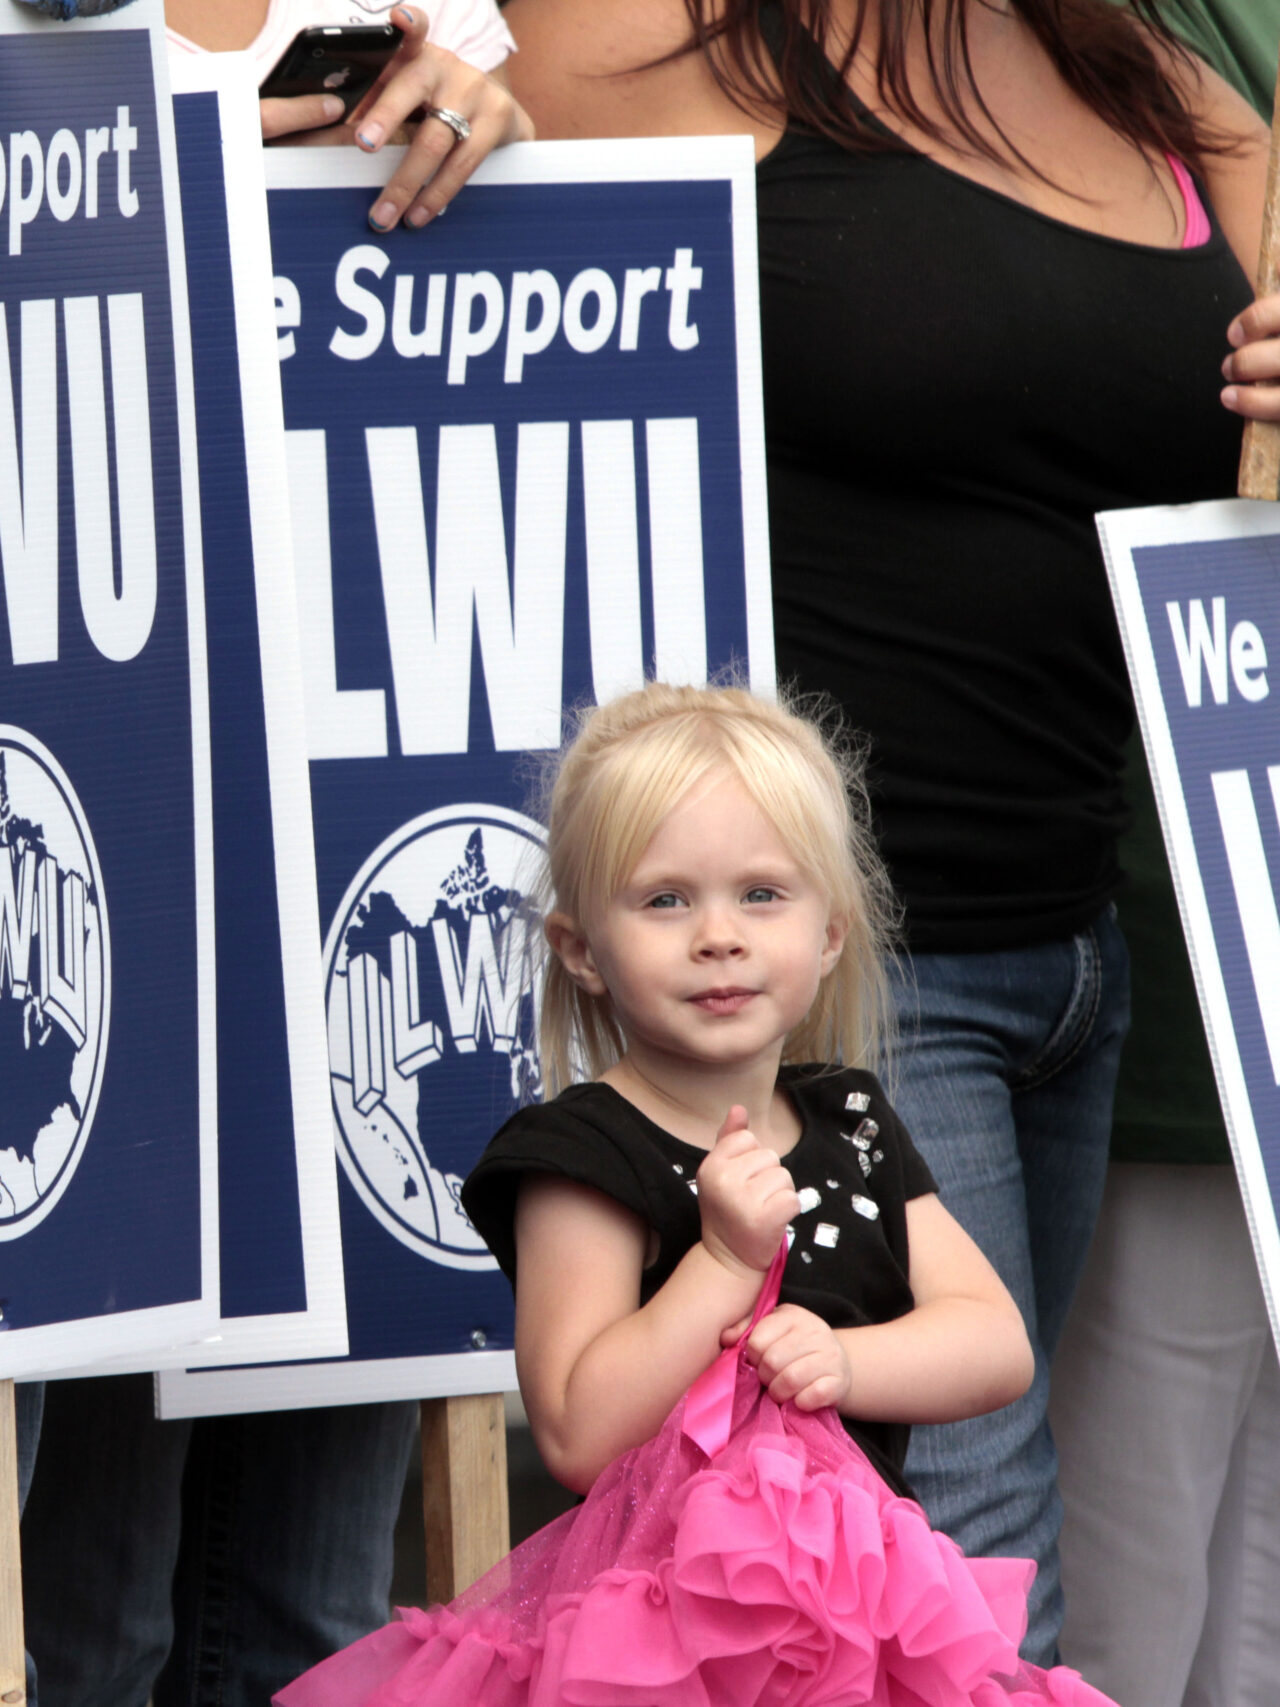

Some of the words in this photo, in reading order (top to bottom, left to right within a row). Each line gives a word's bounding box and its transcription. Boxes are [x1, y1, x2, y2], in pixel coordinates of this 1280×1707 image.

[328, 244, 703, 385] Support
[284, 417, 708, 760] LWU
[1165, 596, 1270, 708] We
[347, 914, 542, 1119] ILW
